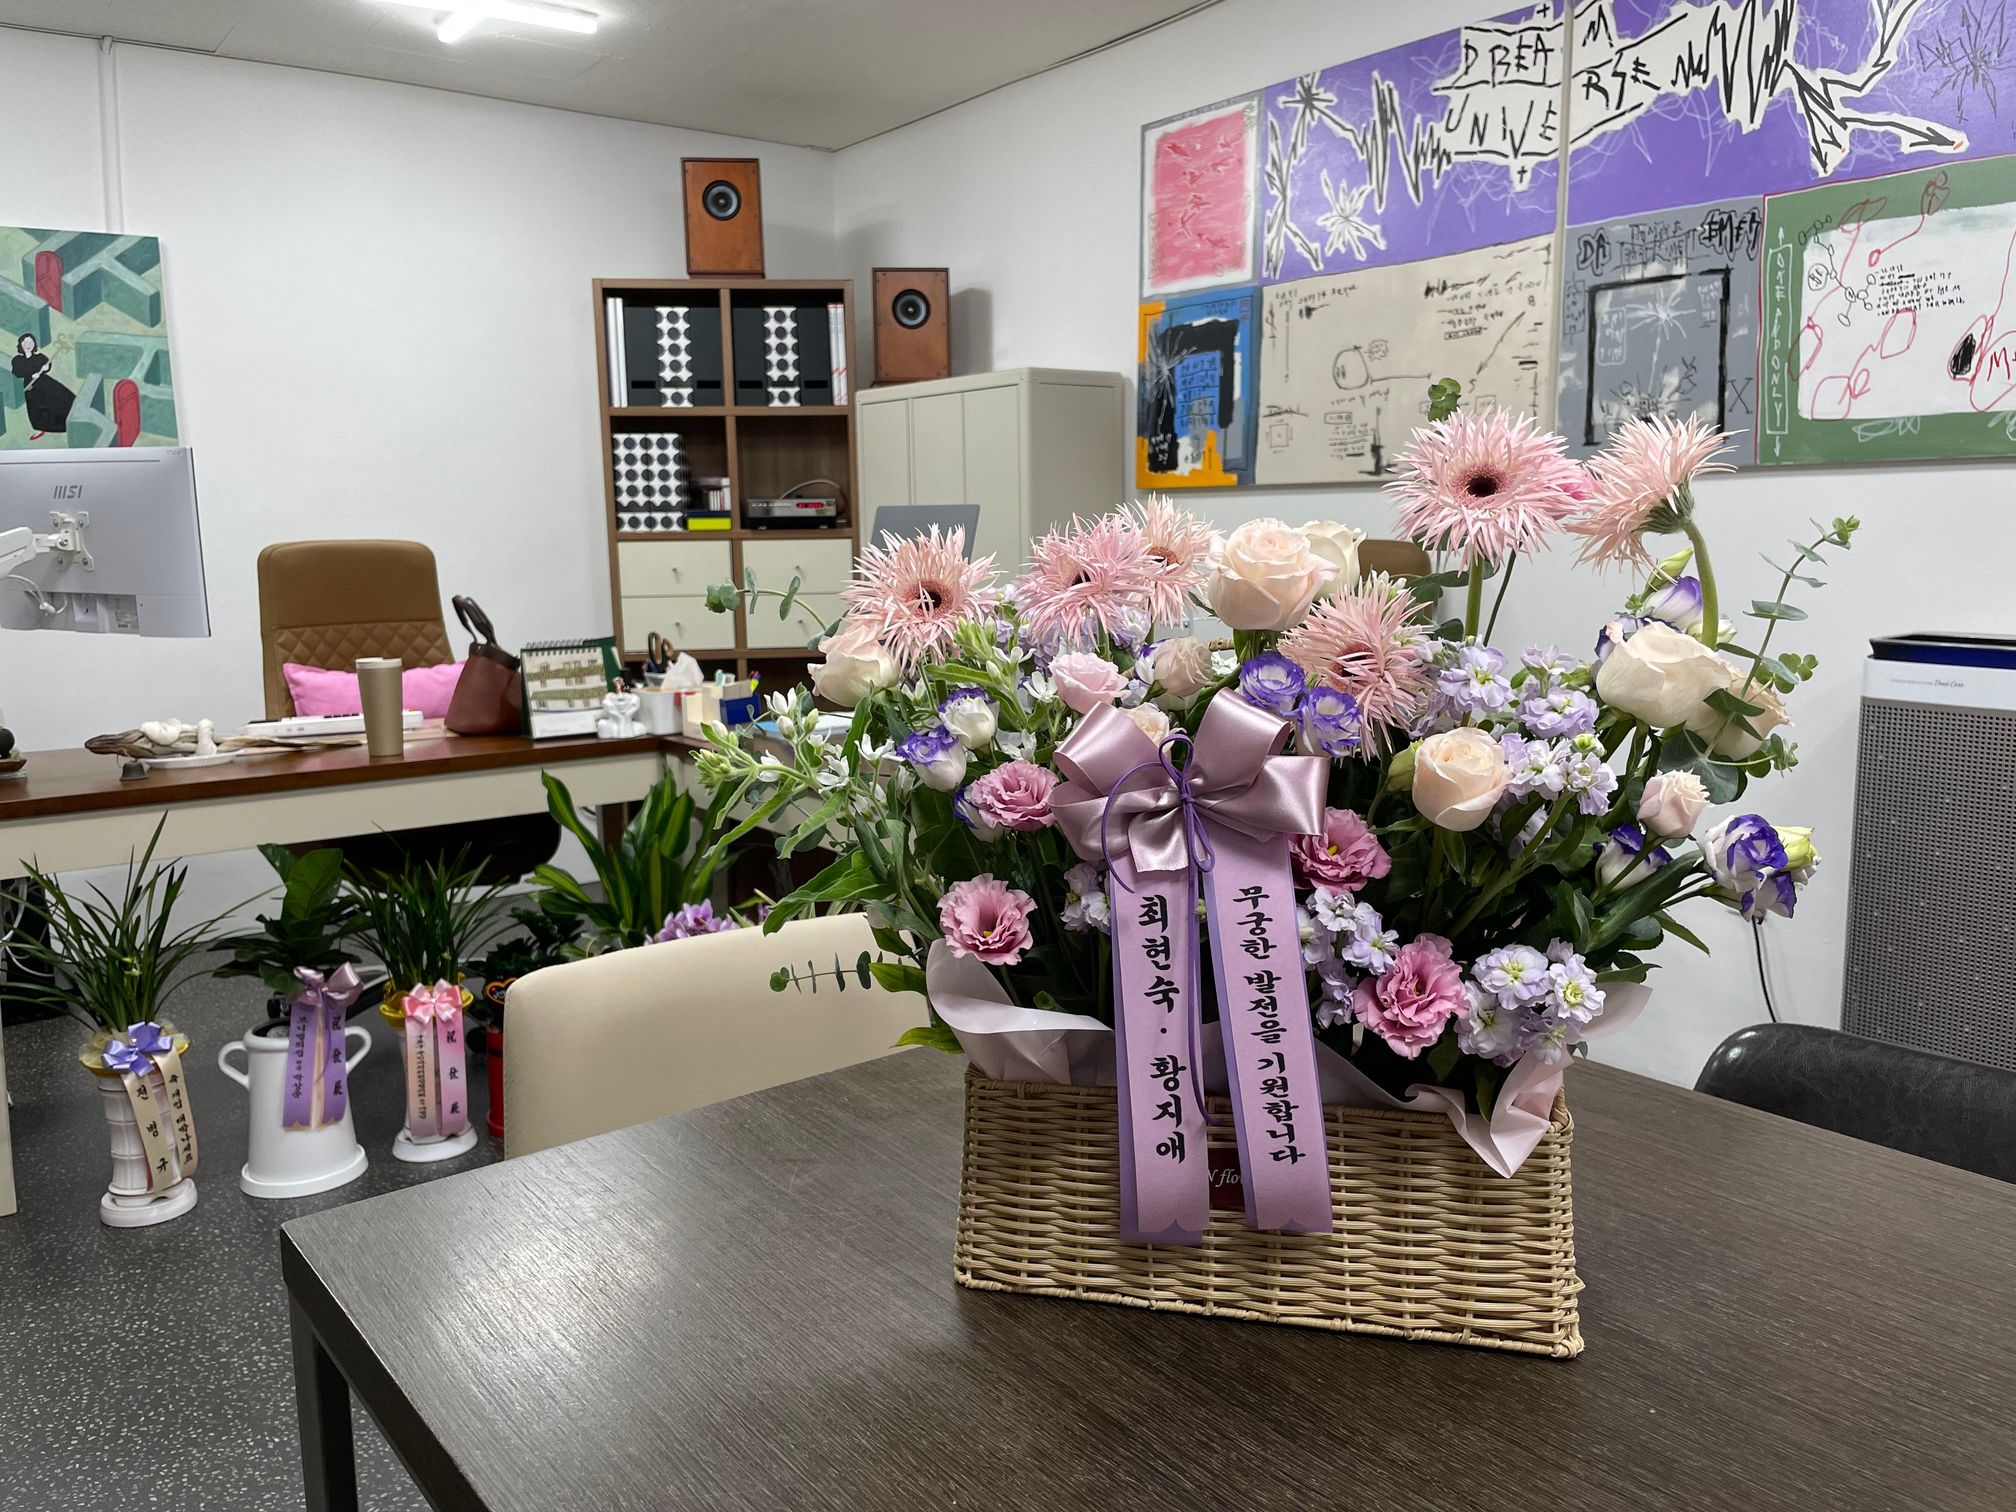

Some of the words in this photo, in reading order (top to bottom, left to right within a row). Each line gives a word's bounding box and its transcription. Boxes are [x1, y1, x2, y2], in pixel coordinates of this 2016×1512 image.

[53, 484, 84, 500] MSI
[1138, 893, 1181, 1014] 최현숙
[1232, 885, 1278, 960] 무궁한
[1243, 969, 1289, 1044] 발전을
[1150, 1054, 1187, 1164] 황지애
[1256, 1052, 1307, 1166] 기원합니다
